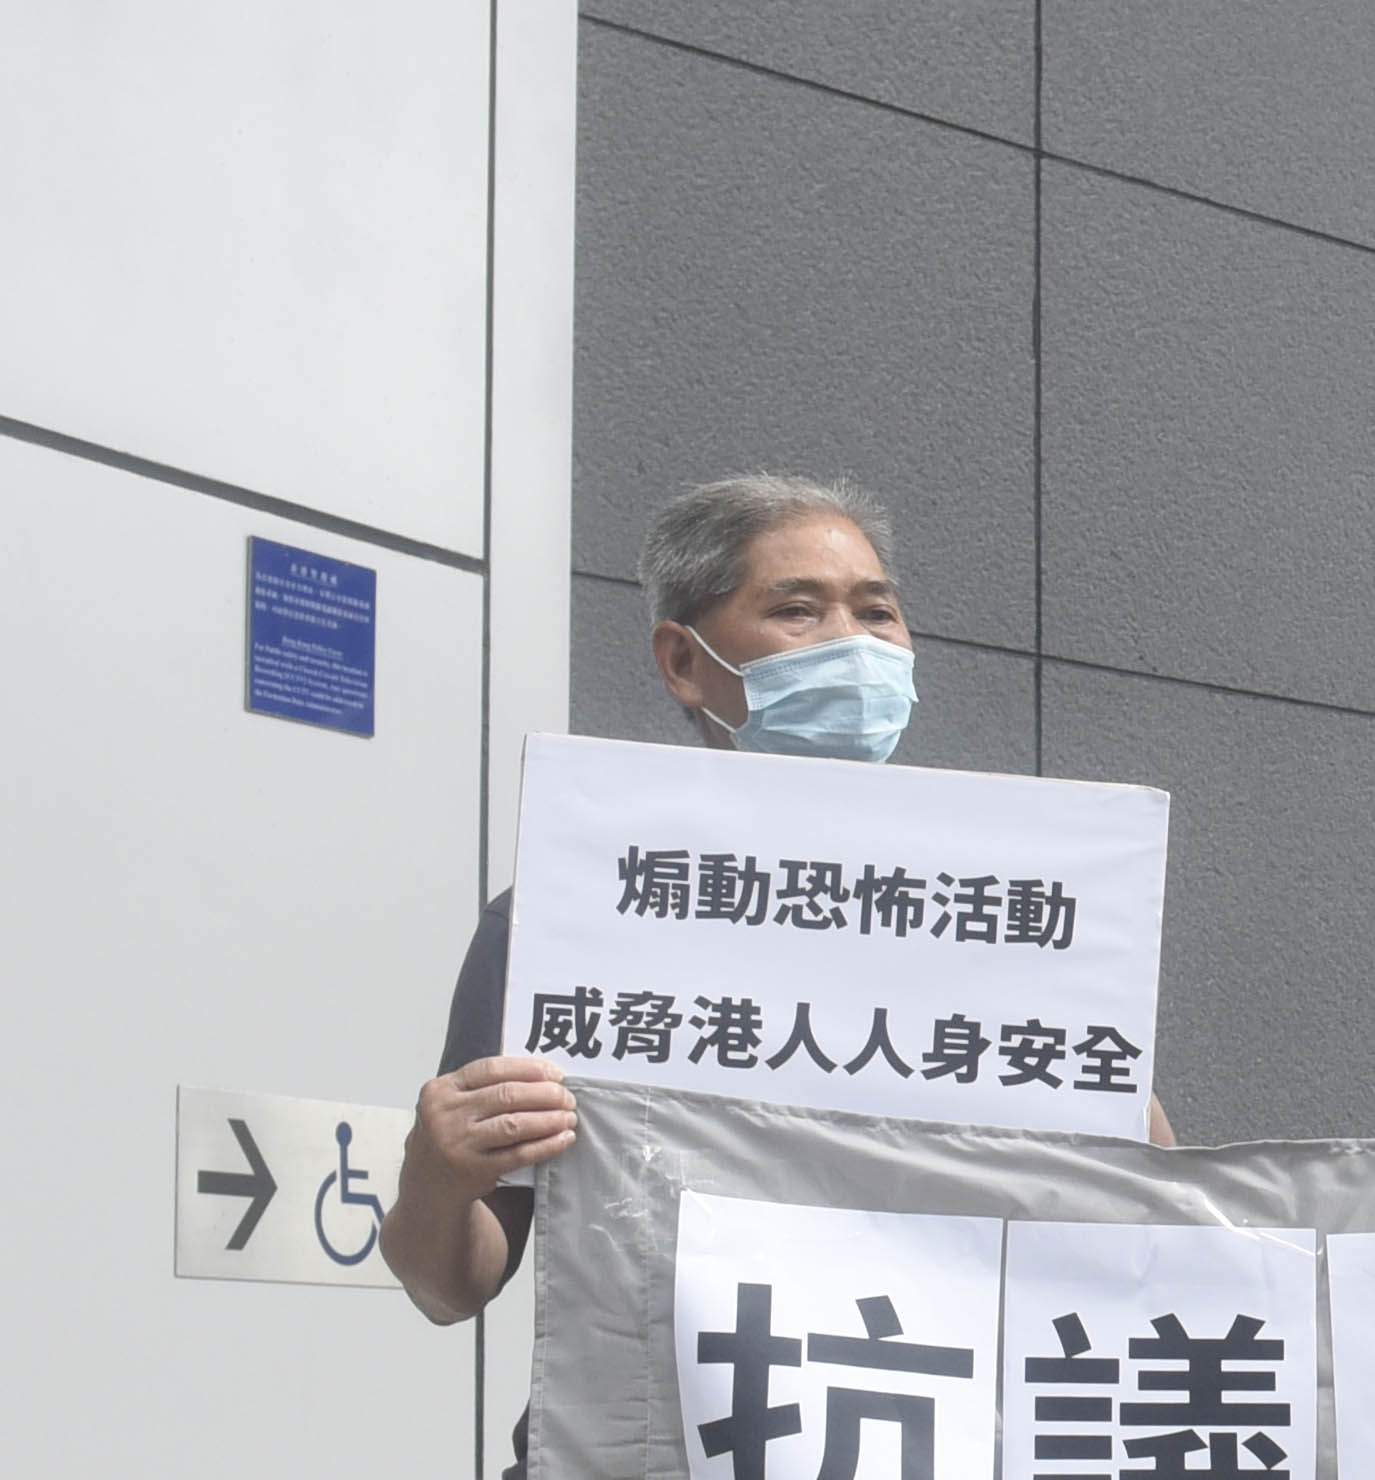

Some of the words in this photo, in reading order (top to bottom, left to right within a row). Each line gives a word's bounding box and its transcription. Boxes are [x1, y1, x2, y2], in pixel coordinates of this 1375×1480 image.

[615, 845, 1077, 951] 煽動恐怖活動
[525, 986, 1144, 1094] 威脅港人人身安全
